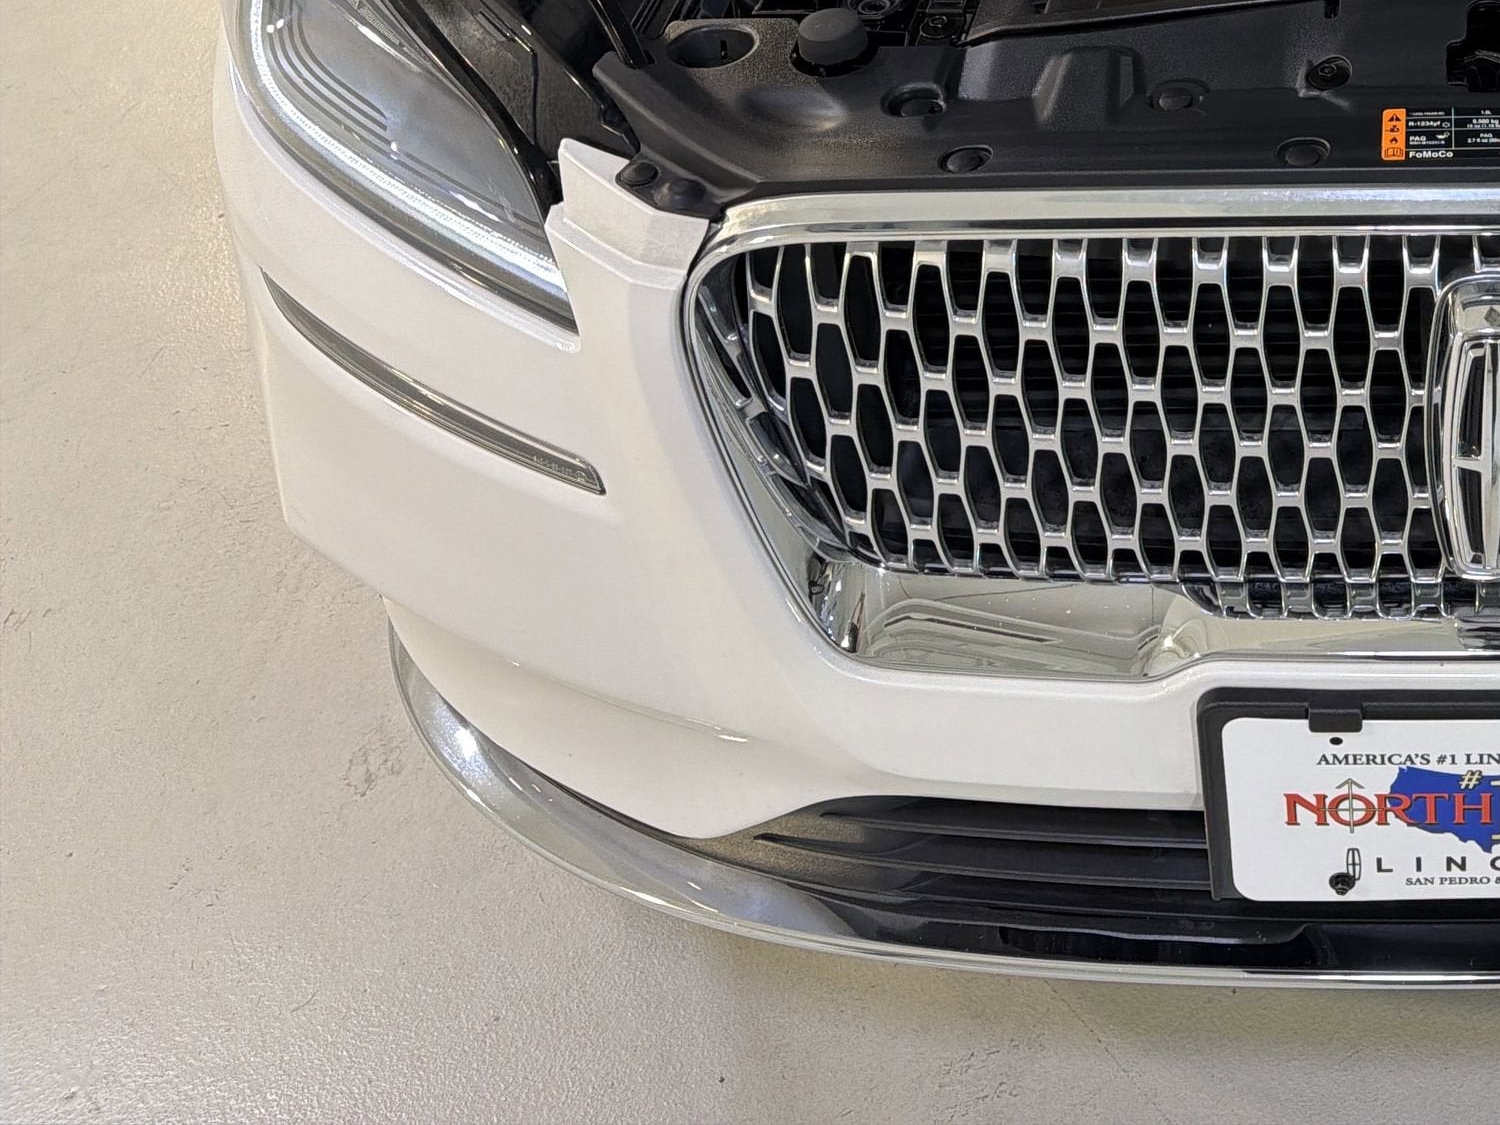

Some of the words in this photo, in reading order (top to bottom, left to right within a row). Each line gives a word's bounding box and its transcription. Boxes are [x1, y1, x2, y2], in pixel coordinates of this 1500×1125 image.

[1409, 150, 1454, 158] FoMoCo
[1316, 753, 1431, 765] AMERICA'S
[1436, 753, 1458, 765] #1
[1284, 792, 1493, 826] NORTH
[1405, 876, 1435, 886] SAN
[1438, 876, 1491, 885] PEDRO
